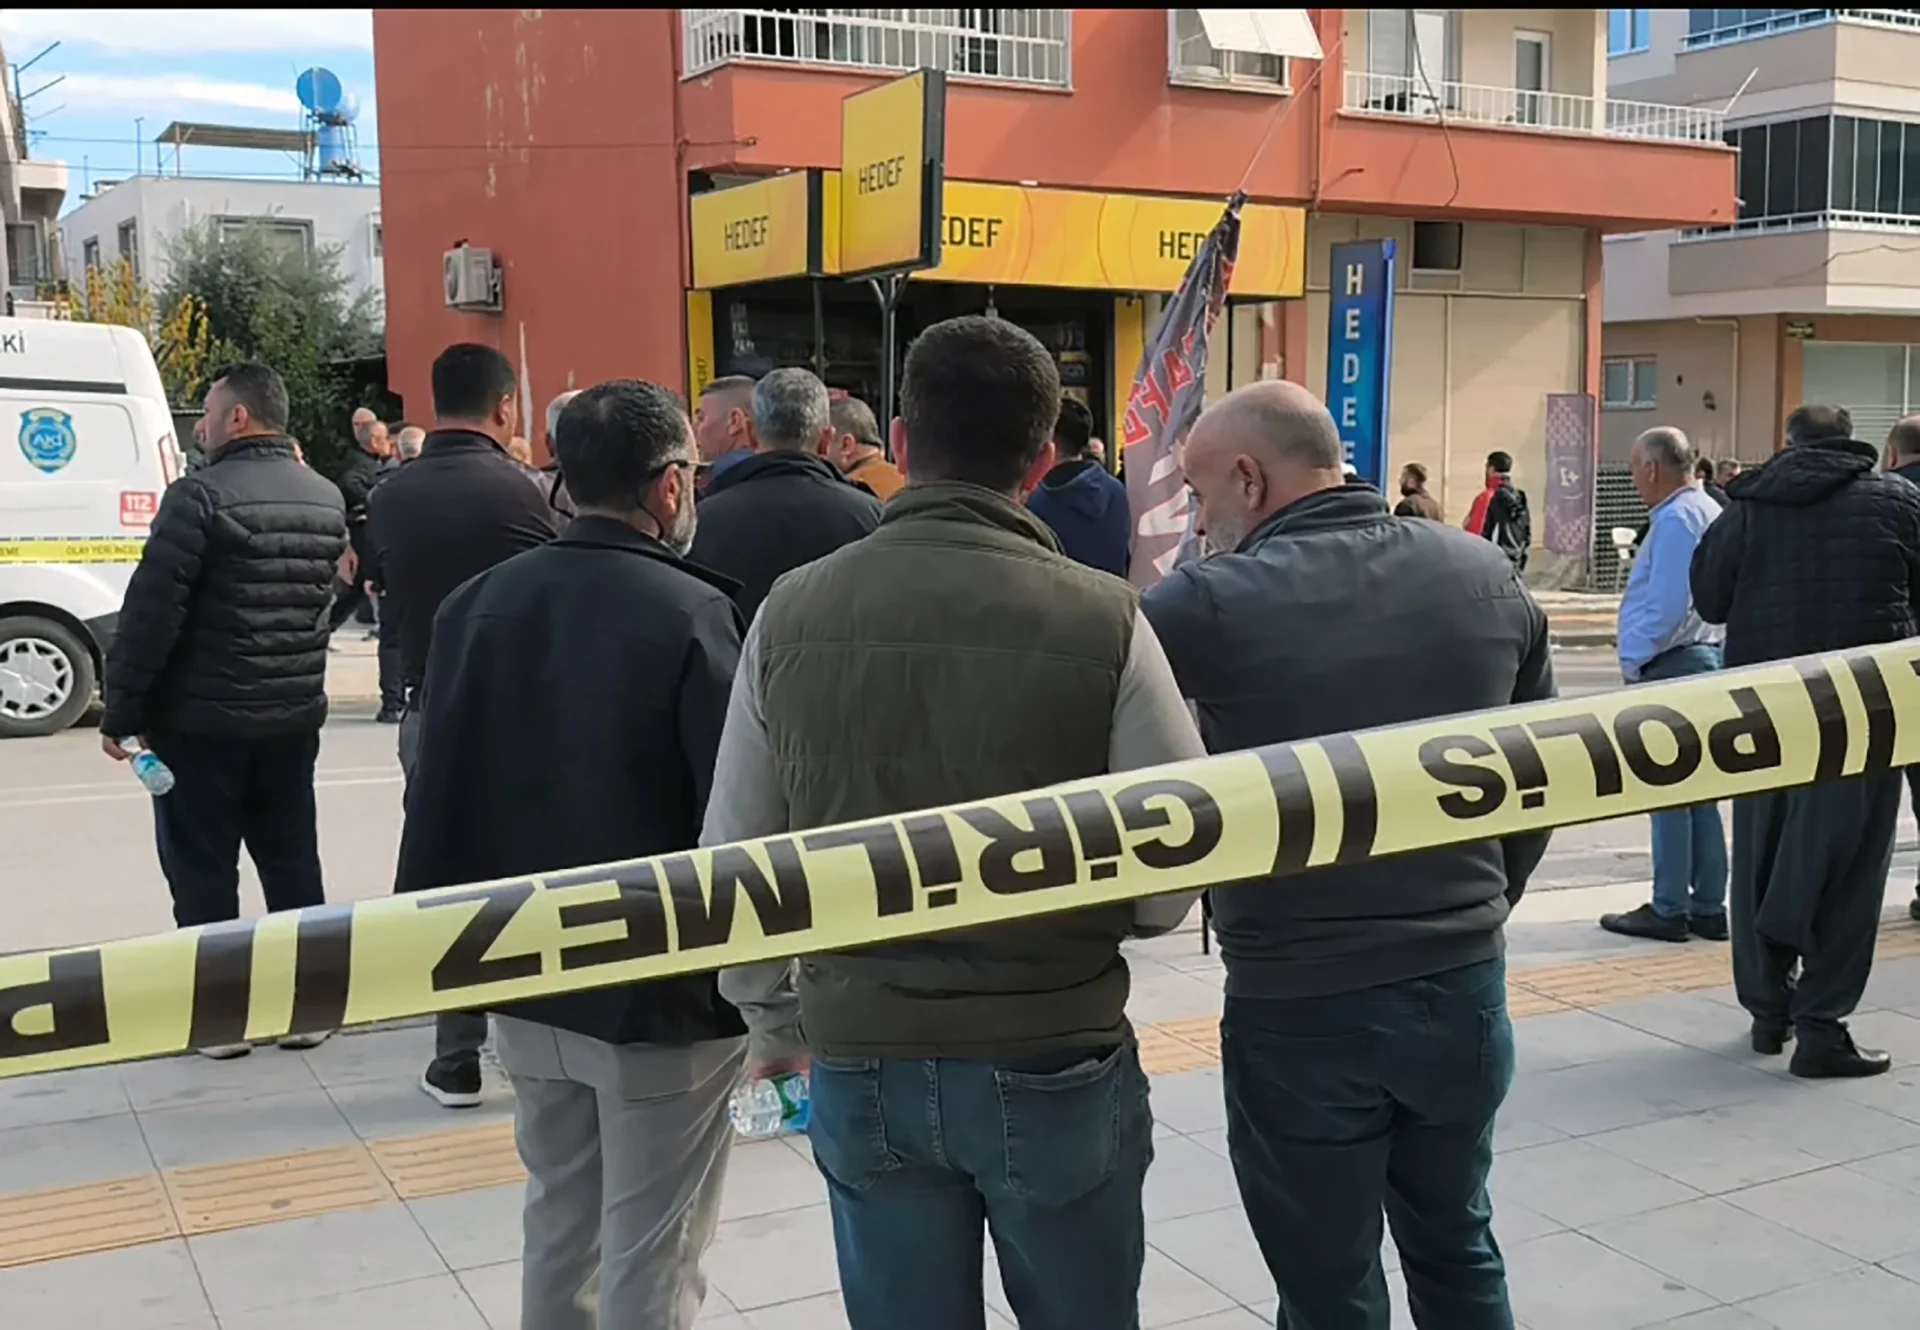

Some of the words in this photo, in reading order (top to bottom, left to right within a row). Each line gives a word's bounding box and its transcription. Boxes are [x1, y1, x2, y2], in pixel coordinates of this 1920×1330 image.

[859, 155, 905, 195] HEDEF
[723, 214, 769, 251] HEDEF
[942, 216, 1002, 248] DEF
[0, 329, 25, 353] Kİ
[124, 494, 152, 511] 112
[1418, 686, 1782, 820] POLİS
[415, 780, 1224, 992] GİRİLMEZ
[0, 948, 110, 1058] P
